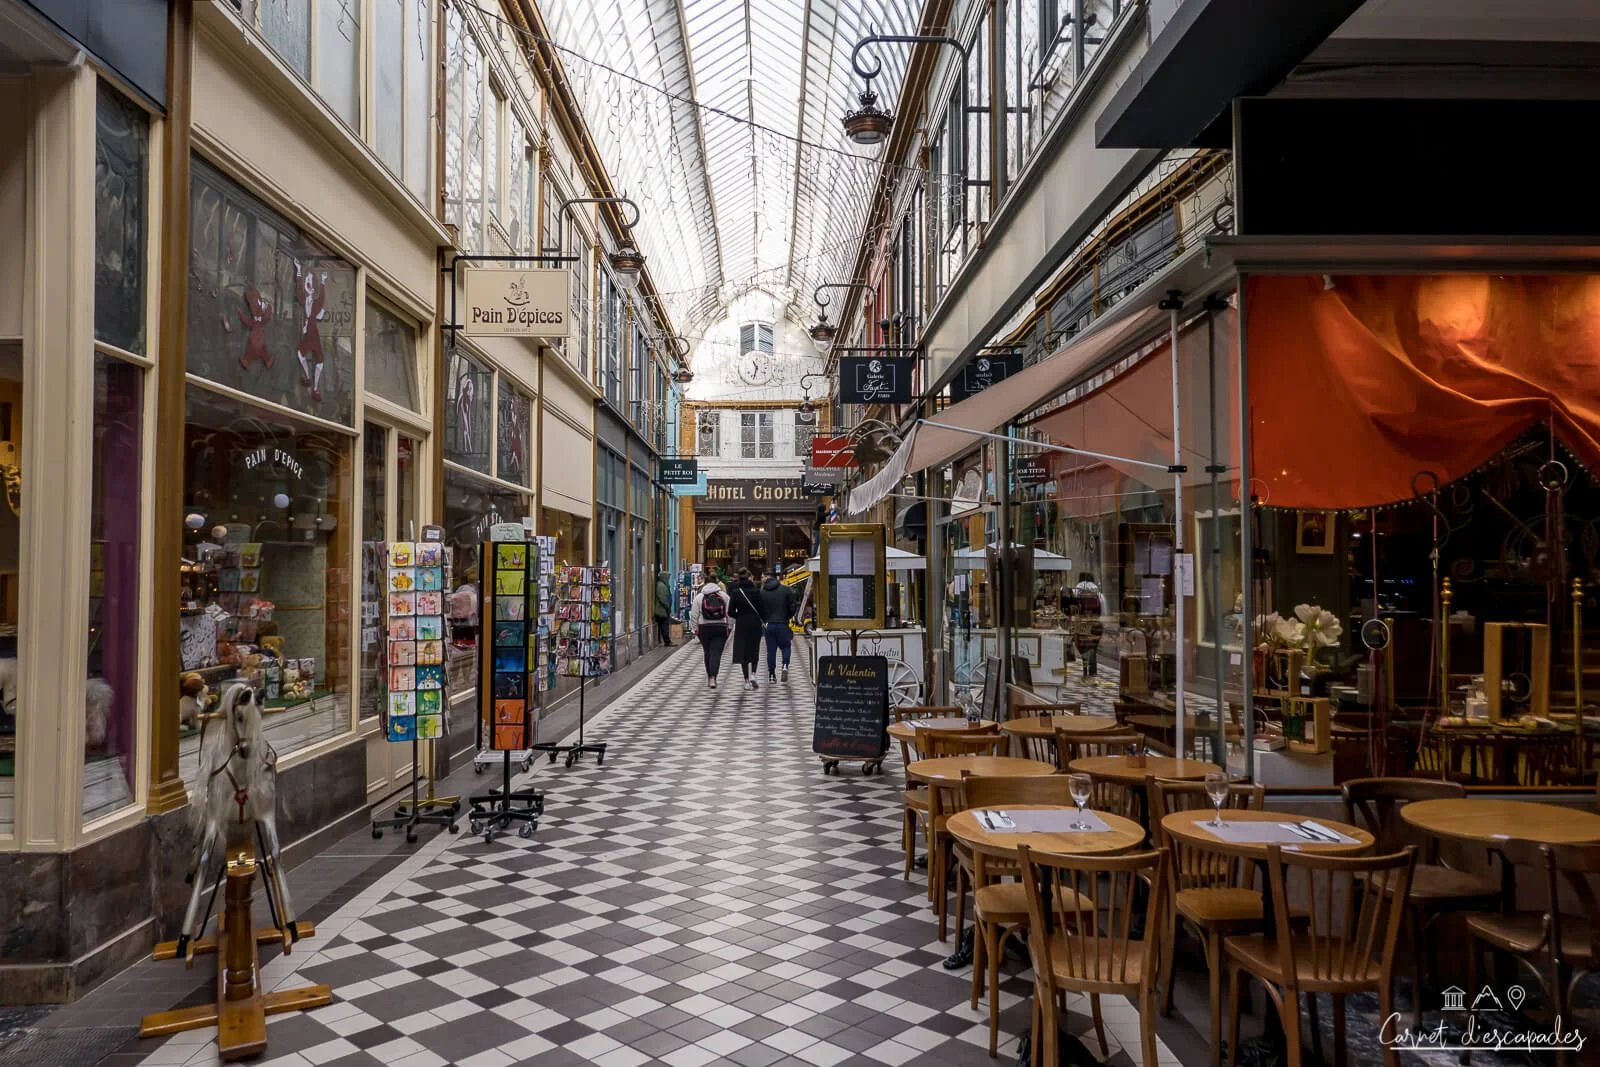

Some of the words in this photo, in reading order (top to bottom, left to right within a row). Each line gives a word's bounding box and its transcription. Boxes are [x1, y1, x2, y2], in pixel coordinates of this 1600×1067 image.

[472, 307, 503, 324] Pain
[507, 307, 563, 328] D'épices
[245, 448, 266, 469] PAIN
[274, 449, 303, 480] D'EPICE
[708, 484, 746, 500] HÔTEL
[838, 663, 877, 678] Valentin
